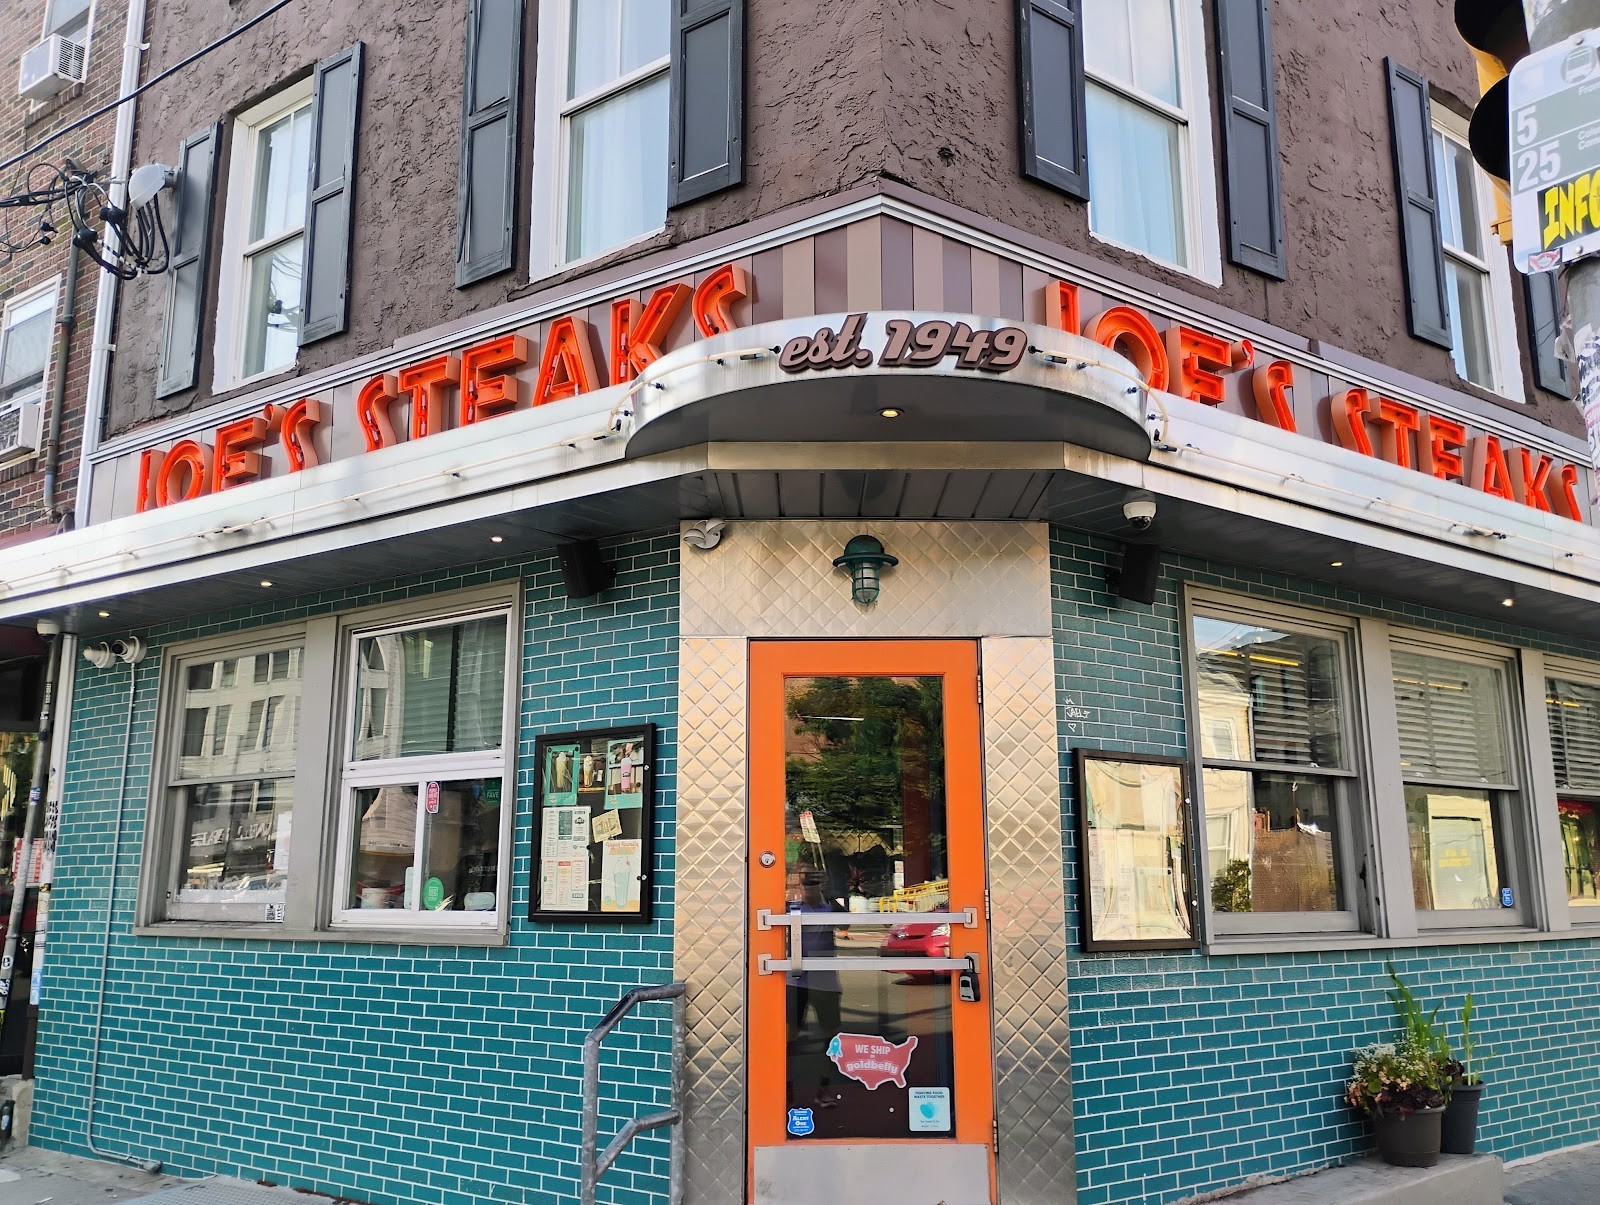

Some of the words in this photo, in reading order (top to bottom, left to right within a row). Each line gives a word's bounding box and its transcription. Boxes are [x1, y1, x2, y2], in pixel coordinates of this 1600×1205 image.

[1517, 105, 1537, 146] 5
[1517, 140, 1561, 191] 25
[356, 264, 747, 452] STEAKS
[779, 313, 873, 373] est.
[878, 319, 1028, 373] 1949
[1330, 387, 1583, 522] STEAKS
[846, 1060, 899, 1075] goldbelly
[854, 1044, 869, 1054] WE
[870, 1045, 891, 1055] SHIP
